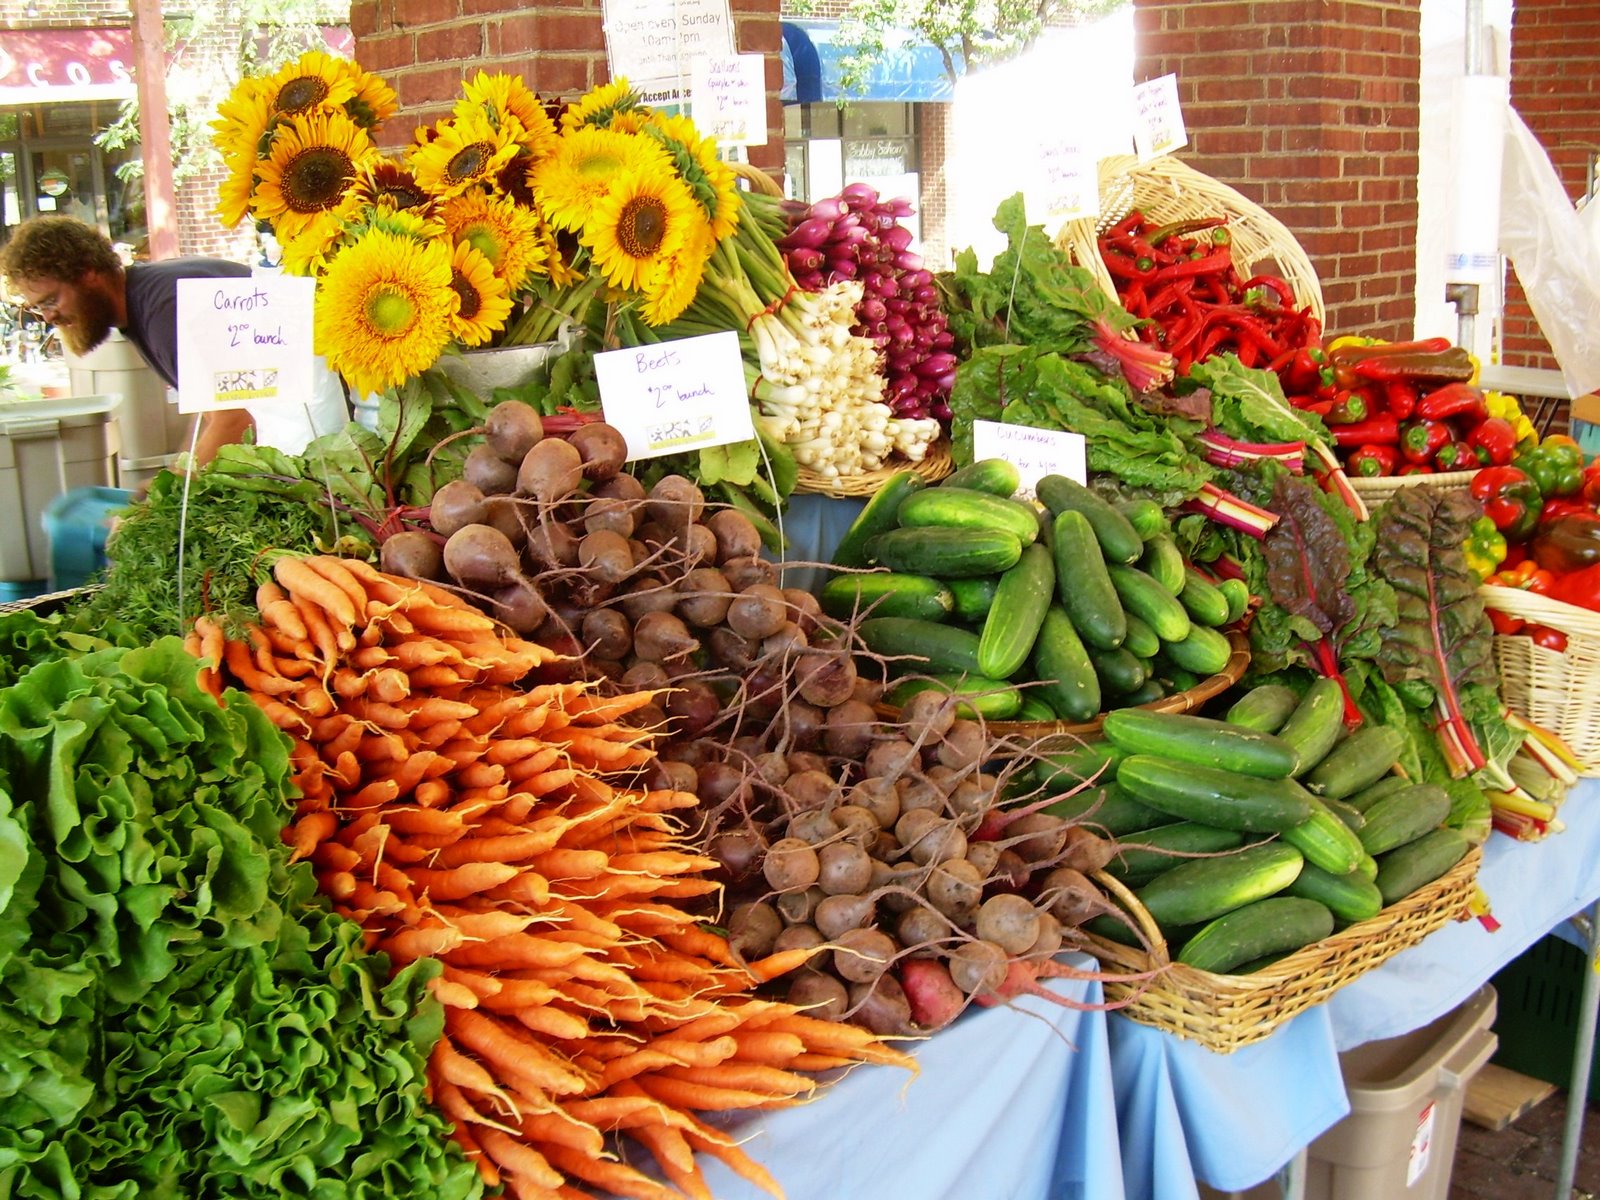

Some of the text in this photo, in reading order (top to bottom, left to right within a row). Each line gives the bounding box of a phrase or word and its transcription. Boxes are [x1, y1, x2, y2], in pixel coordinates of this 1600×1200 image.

[615, 21, 644, 33] Open
[682, 13, 721, 26] Sunday
[642, 32, 700, 47] 10am-pm
[643, 88, 671, 103] Accept
[214, 287, 269, 311] Carrots
[253, 325, 288, 346] bunch
[635, 350, 681, 374] Beets
[676, 382, 716, 402] bunch
